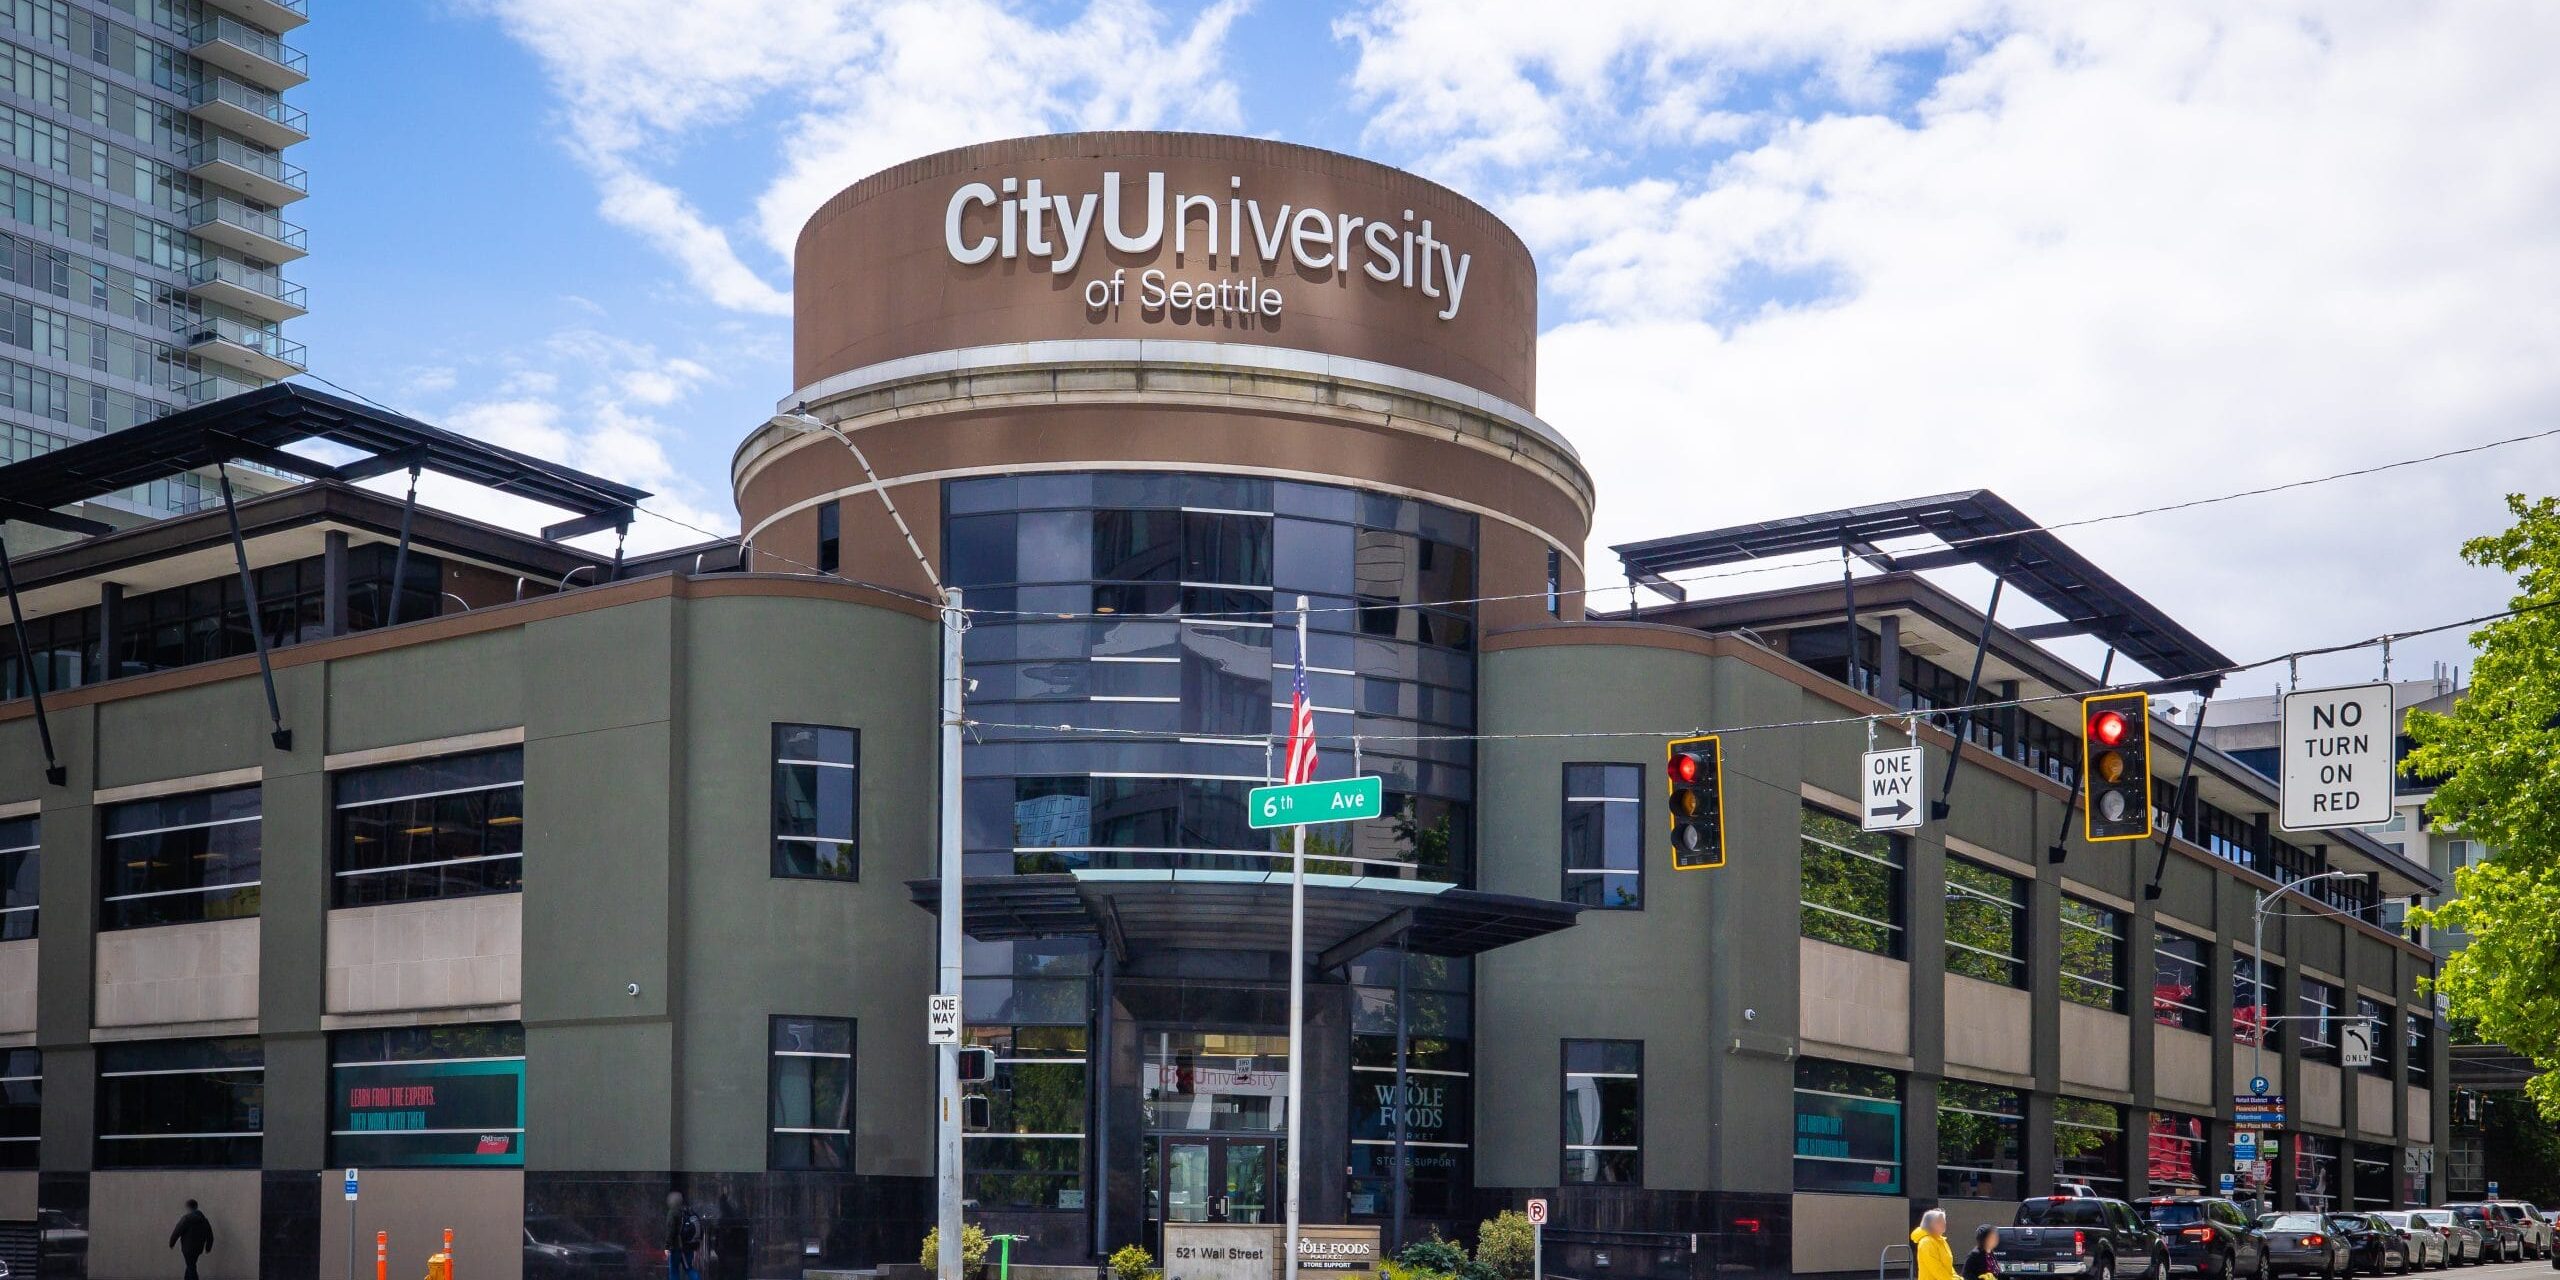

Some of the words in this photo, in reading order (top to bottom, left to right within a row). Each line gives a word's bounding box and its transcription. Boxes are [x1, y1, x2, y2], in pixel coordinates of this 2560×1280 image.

[945, 171, 1471, 320] CityUniversity
[1086, 269, 1126, 308] of
[1140, 269, 1283, 317] Seattle
[2313, 701, 2362, 730] NO
[2305, 734, 2369, 758] TURN
[1874, 756, 1911, 774] ONE
[2320, 764, 2352, 784] ON
[1873, 776, 1912, 796] WAY
[1263, 795, 1293, 818] 6th
[1331, 792, 1365, 810] Ave
[2313, 791, 2360, 812] RED
[933, 999, 955, 1010] ONE
[932, 1013, 955, 1024] WAY
[2345, 1054, 2368, 1062] ONLY
[351, 1088, 371, 1107] LEARN
[372, 1088, 390, 1106] FROM
[392, 1087, 404, 1106] THE
[367, 1112, 387, 1131] WORK
[1387, 1131, 1434, 1140] MRKET
[1376, 1156, 1410, 1166] STOE
[1414, 1158, 1457, 1168] SUPPORT
[1176, 1247, 1196, 1259] 521
[1200, 1248, 1225, 1259] Wall
[1229, 1248, 1263, 1260] Street
[1284, 1243, 1327, 1254] HOLE
[1331, 1243, 1370, 1254] FOODS
